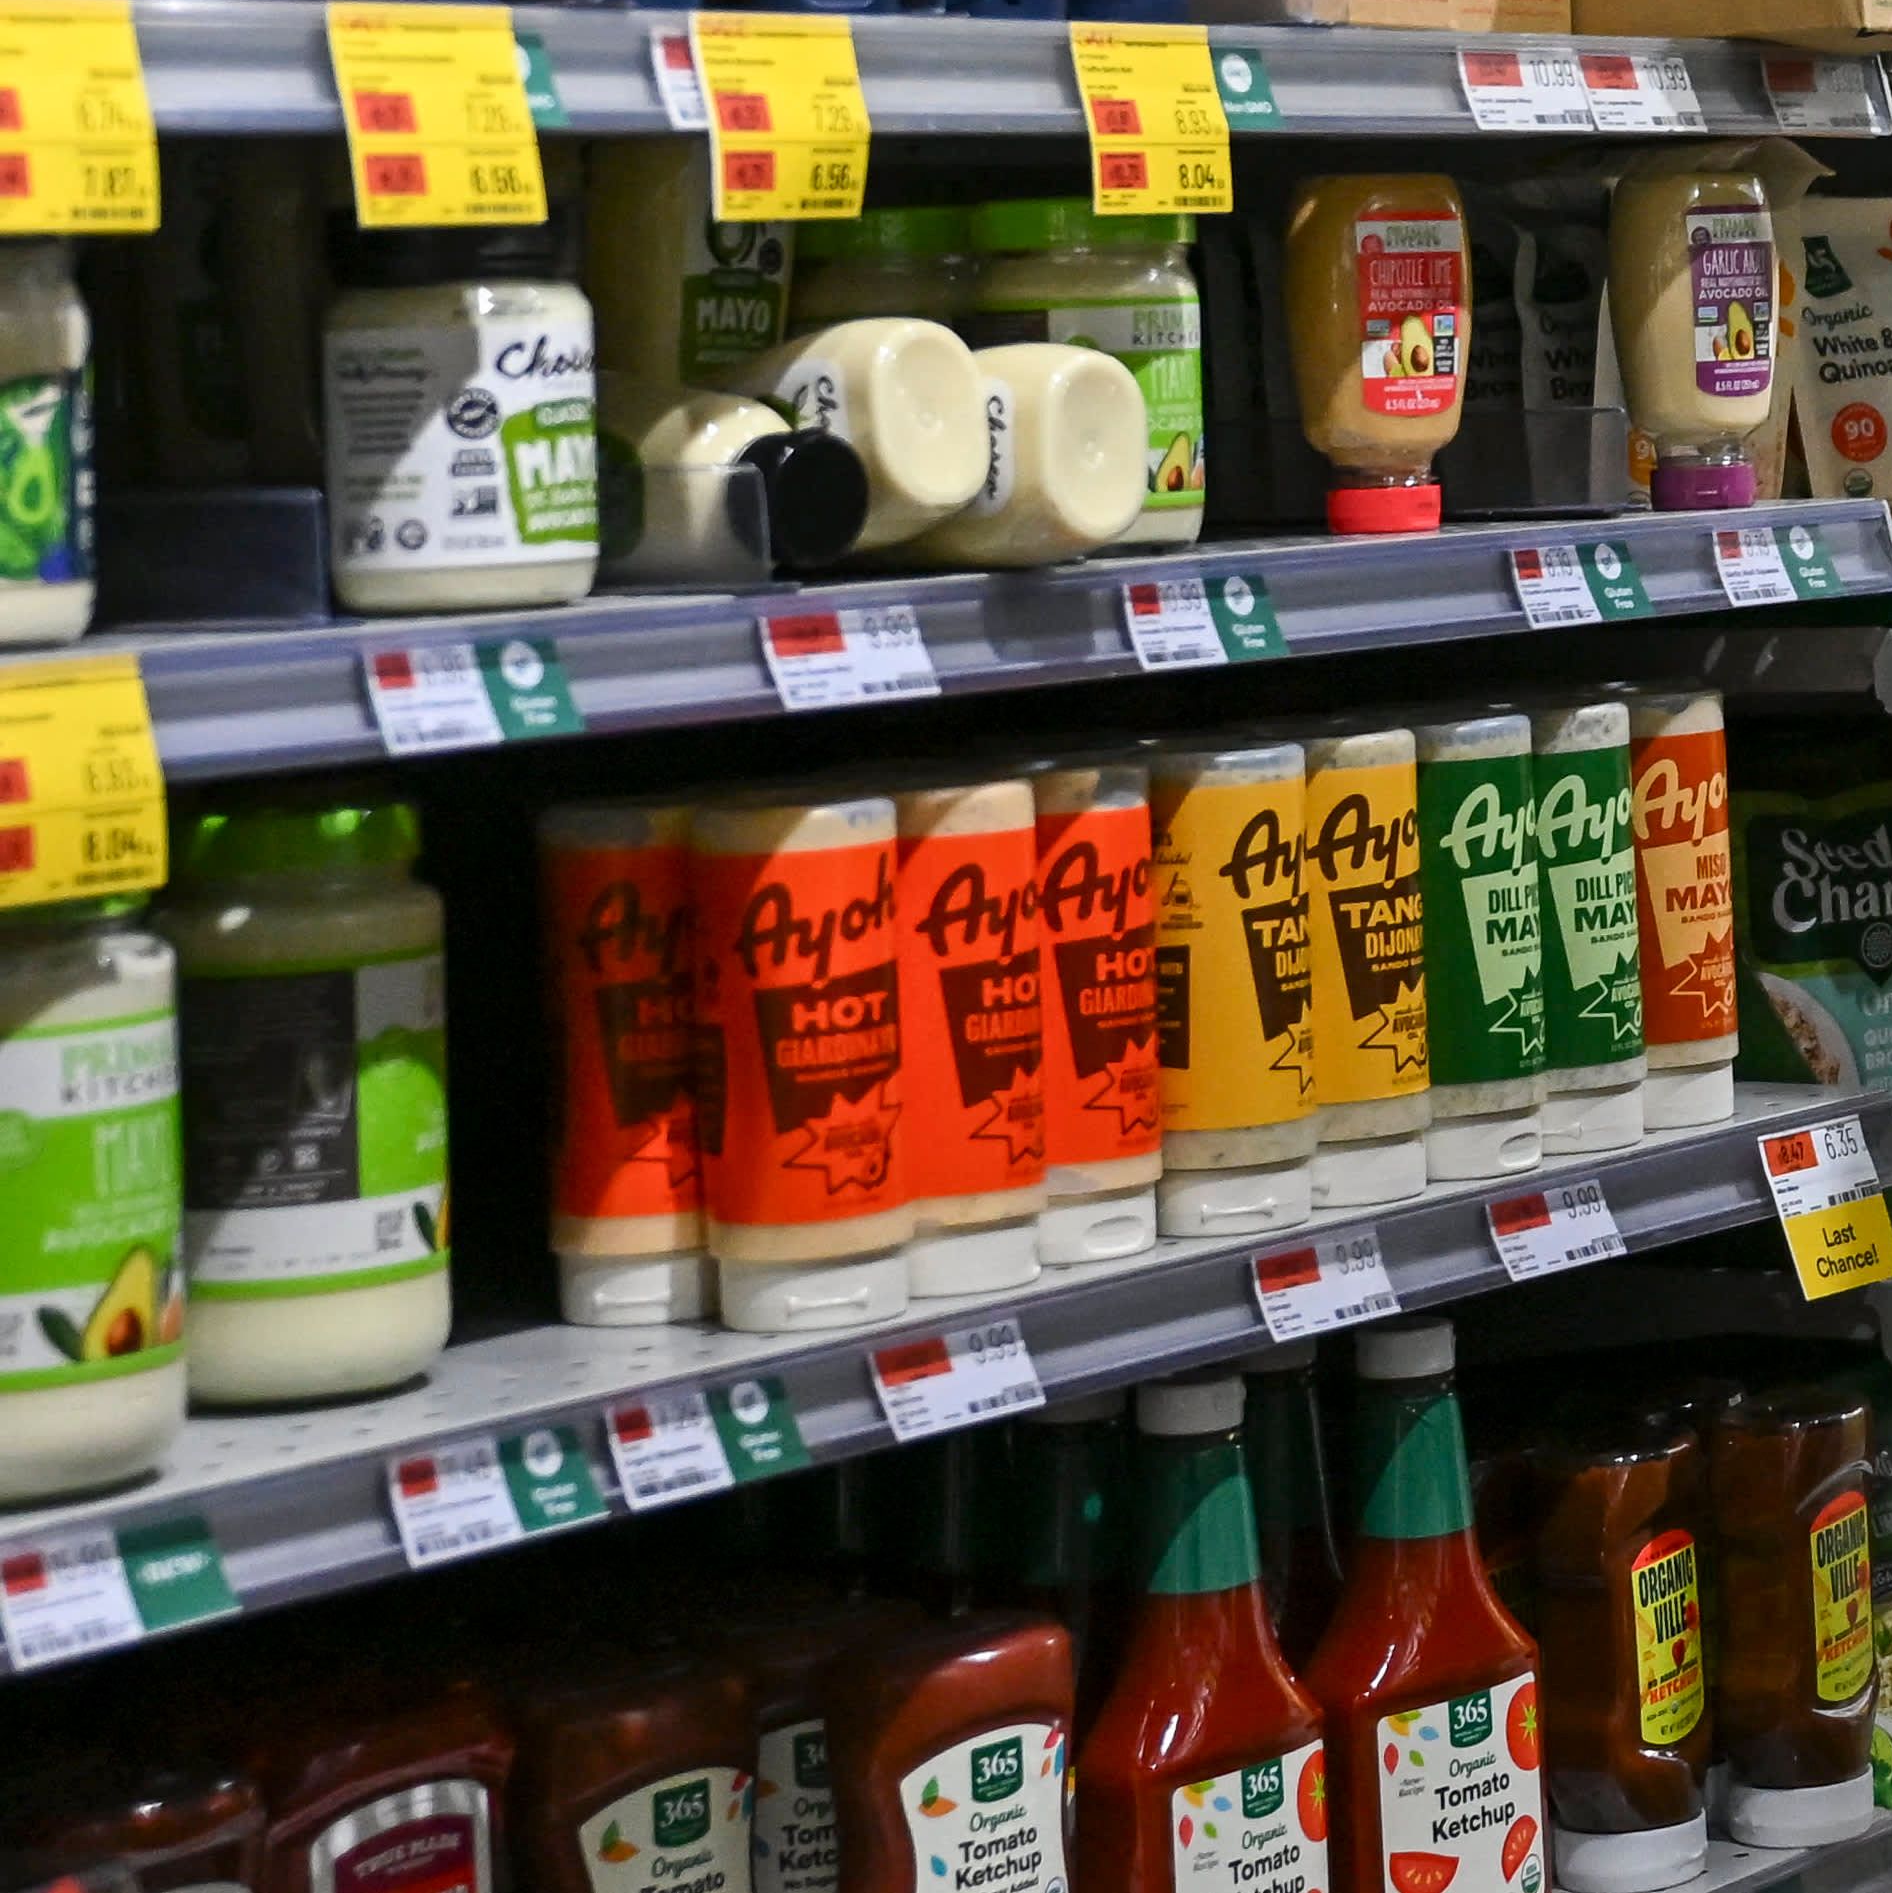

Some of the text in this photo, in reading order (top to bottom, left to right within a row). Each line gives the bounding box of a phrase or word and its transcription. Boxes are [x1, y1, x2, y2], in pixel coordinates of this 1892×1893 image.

[1641, 57, 1688, 92] 10.99
[1179, 162, 1216, 189] 8.04
[1369, 257, 1426, 288] CHIPOTLE
[1812, 331, 1879, 358] White
[1844, 419, 1874, 440] 90
[1695, 852, 1726, 881] MISO
[1488, 887, 1521, 915] DILL
[1575, 875, 1611, 905] DILL
[735, 851, 897, 980] Ayoh
[793, 992, 887, 1034] HOT
[1823, 1124, 1860, 1161] 6.35
[1562, 1185, 1601, 1220] 9.99
[1822, 1220, 1858, 1248] Last
[1815, 1242, 1880, 1280] Chance!
[1816, 1510, 1866, 1568] ORGANIC
[1638, 1548, 1695, 1605] ORGANIC
[1655, 1595, 1688, 1644] VILLE
[1454, 1698, 1488, 1732] 365
[976, 1750, 1021, 1784] 365
[1449, 1751, 1496, 1780] Organic
[1246, 1766, 1280, 1800] 365
[1434, 1771, 1511, 1812] Tomato
[969, 1802, 1026, 1834] Organic
[1431, 1798, 1516, 1844] Ketchup
[958, 1825, 1038, 1866] Tomato
[1241, 1823, 1288, 1851] Organic
[955, 1849, 1043, 1892] Ketchup
[1228, 1844, 1301, 1885] Tomato
